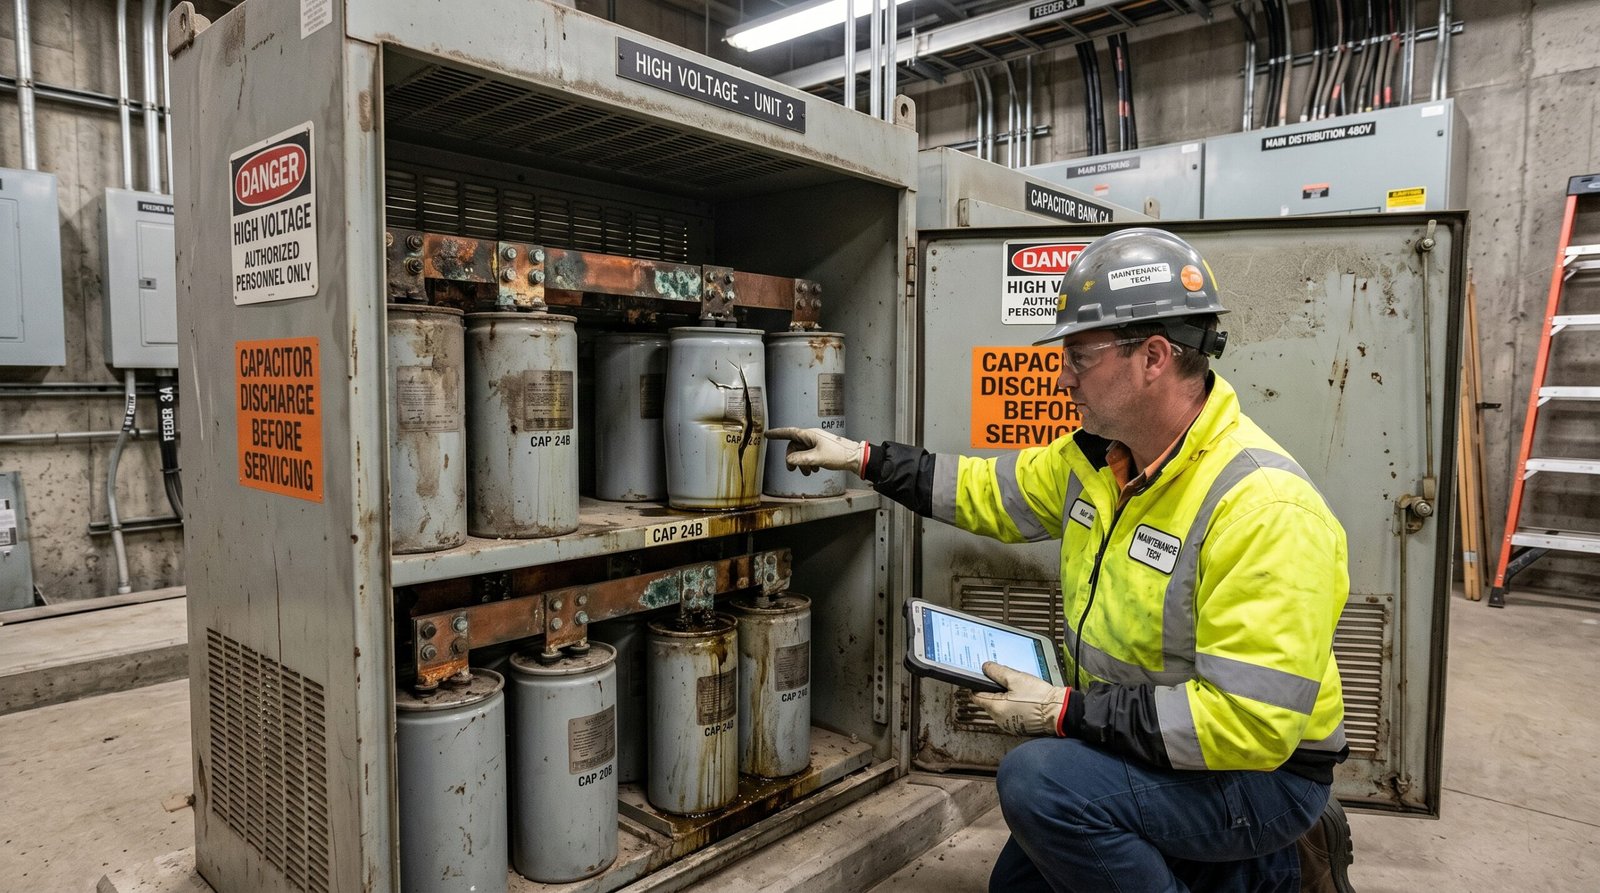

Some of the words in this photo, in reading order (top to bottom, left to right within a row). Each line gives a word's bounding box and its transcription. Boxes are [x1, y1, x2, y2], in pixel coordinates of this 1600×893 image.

[1034, 1, 1064, 17] FEEDER
[1066, 0, 1078, 8] 3A
[636, 51, 672, 83] HIGH
[678, 65, 739, 104] VOLTAGE
[754, 91, 782, 117] UNIT
[786, 103, 794, 121] 3
[1265, 136, 1286, 148] MAIN
[1288, 128, 1345, 145] DISTRIBUTION
[1347, 124, 1372, 136] 480V
[241, 152, 300, 199] DANGER
[1078, 165, 1096, 175] MAIN
[142, 203, 165, 212] FEEDER
[1031, 189, 1076, 218] CAPACITOR
[1078, 203, 1098, 222] BANK
[234, 217, 259, 245] HIGH
[261, 202, 311, 239] VOLTAGE
[245, 241, 299, 269] AUTHORIZED
[1022, 251, 1080, 268] DAN
[236, 266, 285, 292] PERSONNEL
[287, 262, 312, 284] ONLY
[1111, 265, 1167, 280] MAINTENANCE
[1130, 275, 1151, 284] TECH
[1008, 281, 1046, 294] HIGH
[1023, 297, 1059, 306] AUTHO
[1008, 308, 1057, 316] PERSONN
[240, 346, 313, 378] CAPACITOR
[982, 352, 1064, 372] CAPAC
[159, 386, 173, 402] 3A
[981, 376, 1069, 396] DISCHA
[241, 383, 315, 415] DISCHARGE
[1004, 400, 1080, 421] BEFOR
[162, 408, 175, 441] FEEDER
[822, 421, 835, 430] CAP
[986, 424, 1077, 445] SERVIC
[252, 418, 303, 452] BEFORE
[531, 436, 551, 448] CAP
[555, 435, 571, 446] 24B
[726, 434, 741, 444] CAP
[245, 451, 314, 491] SERVICING
[653, 527, 677, 543] CAP
[681, 522, 703, 538] 24B
[1137, 532, 1178, 556] MAINTENANCE
[1145, 548, 1161, 561] TECH
[781, 692, 796, 702] CAP
[705, 726, 721, 737] CAP
[578, 772, 597, 787] CAP
[599, 764, 613, 780] 20B
